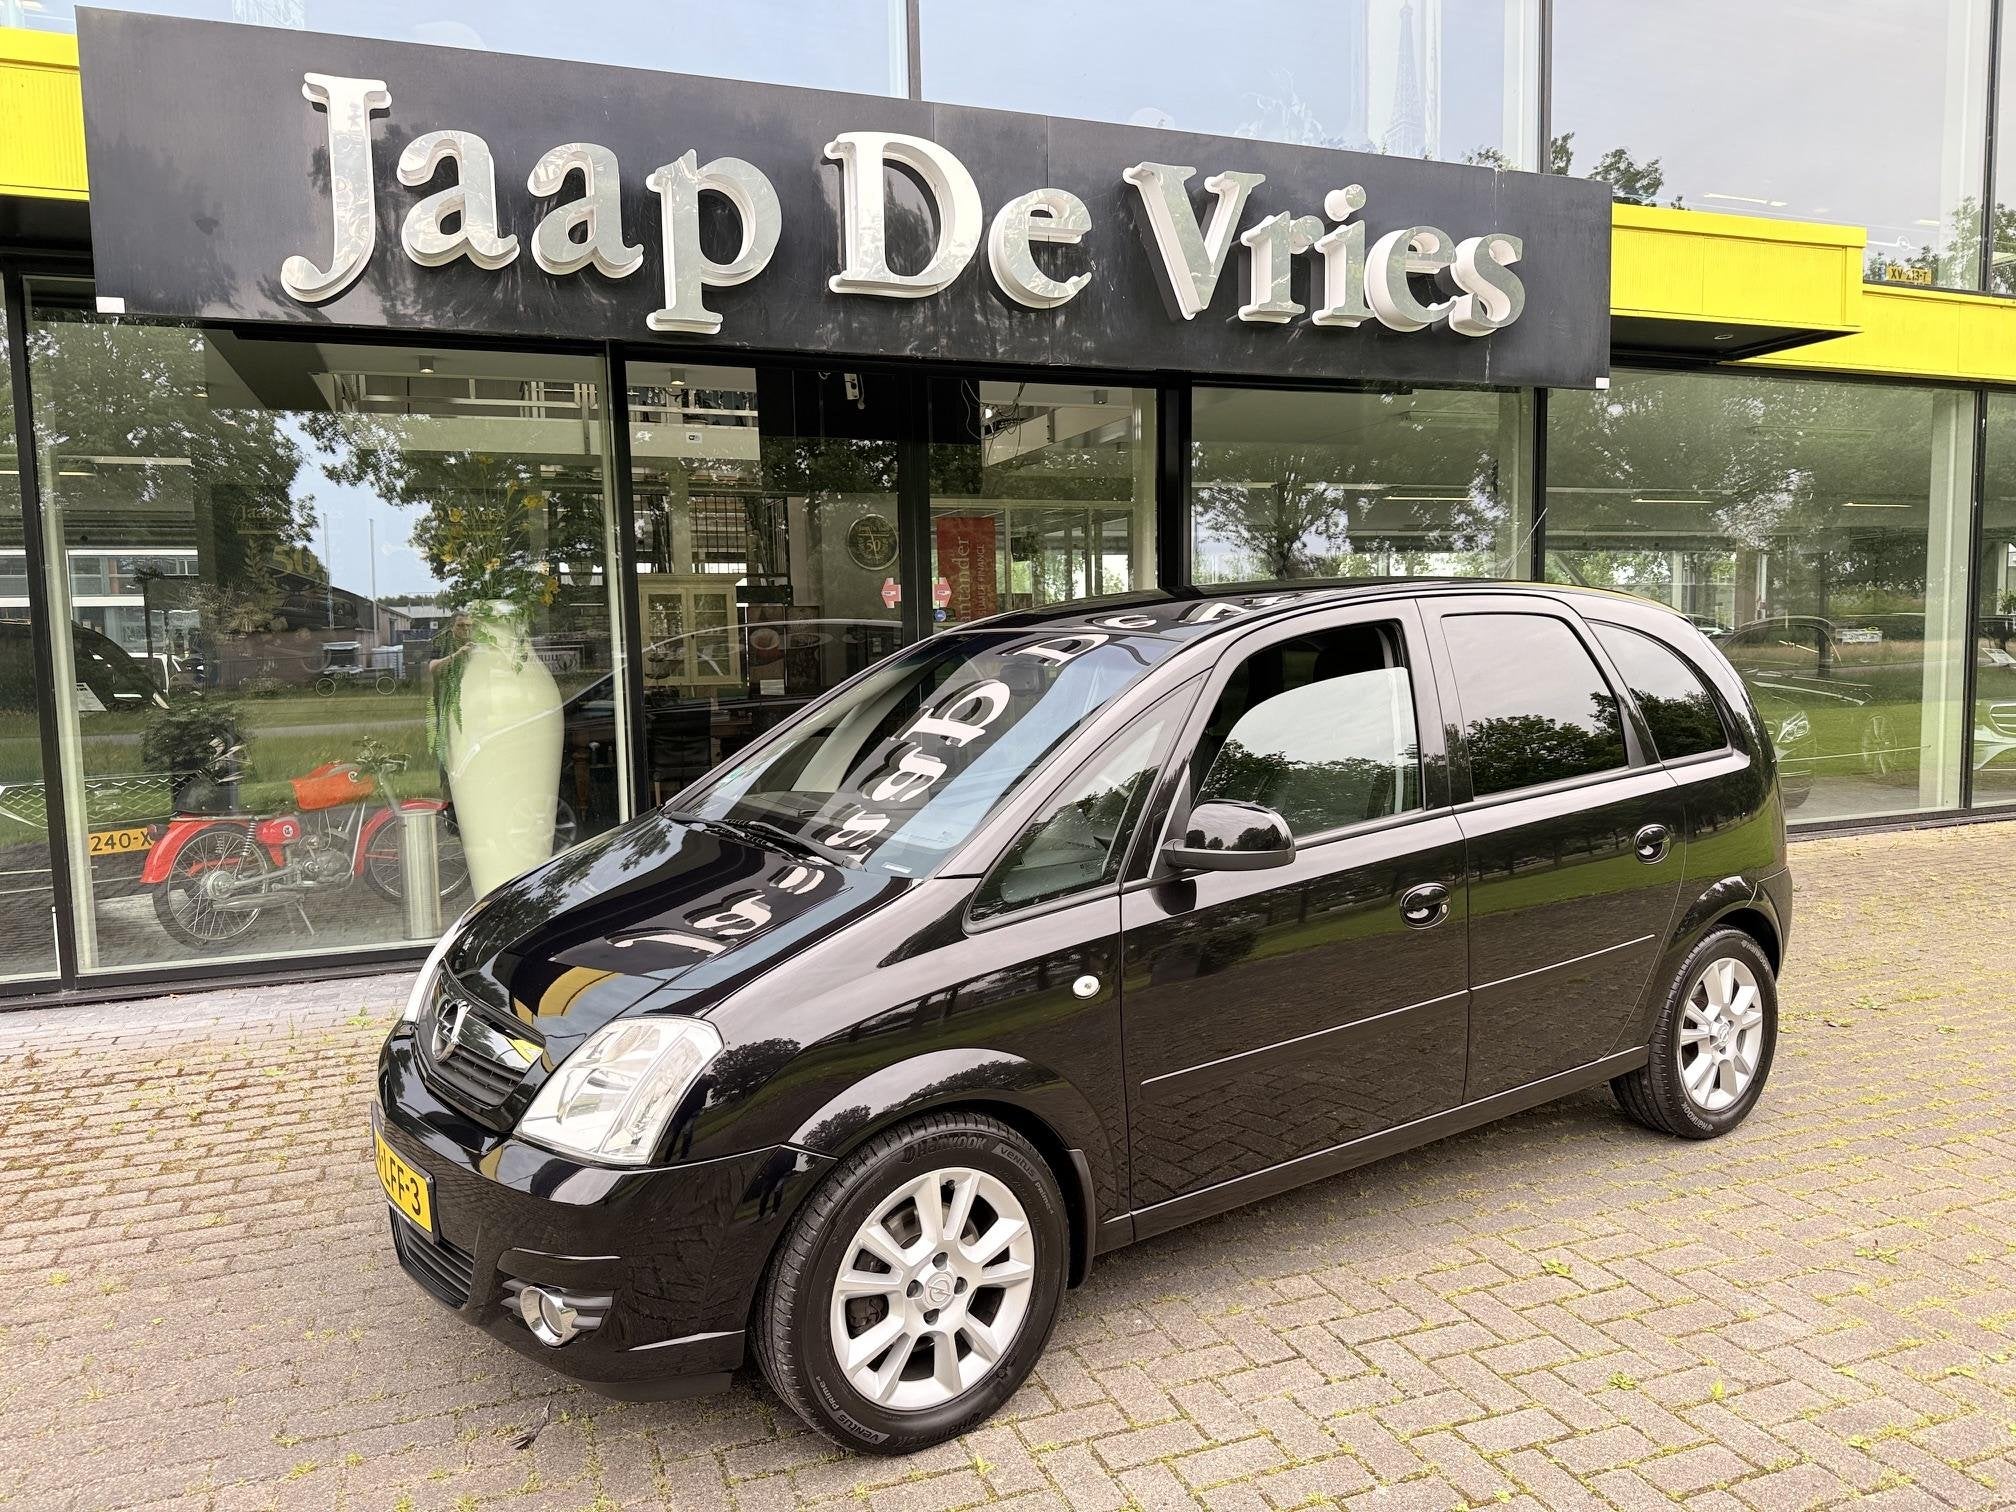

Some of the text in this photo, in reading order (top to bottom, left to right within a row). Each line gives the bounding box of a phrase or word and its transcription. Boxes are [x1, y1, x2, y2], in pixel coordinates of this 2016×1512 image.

[280, 72, 1526, 338] Jaap De Vries
[951, 535, 971, 621] antander
